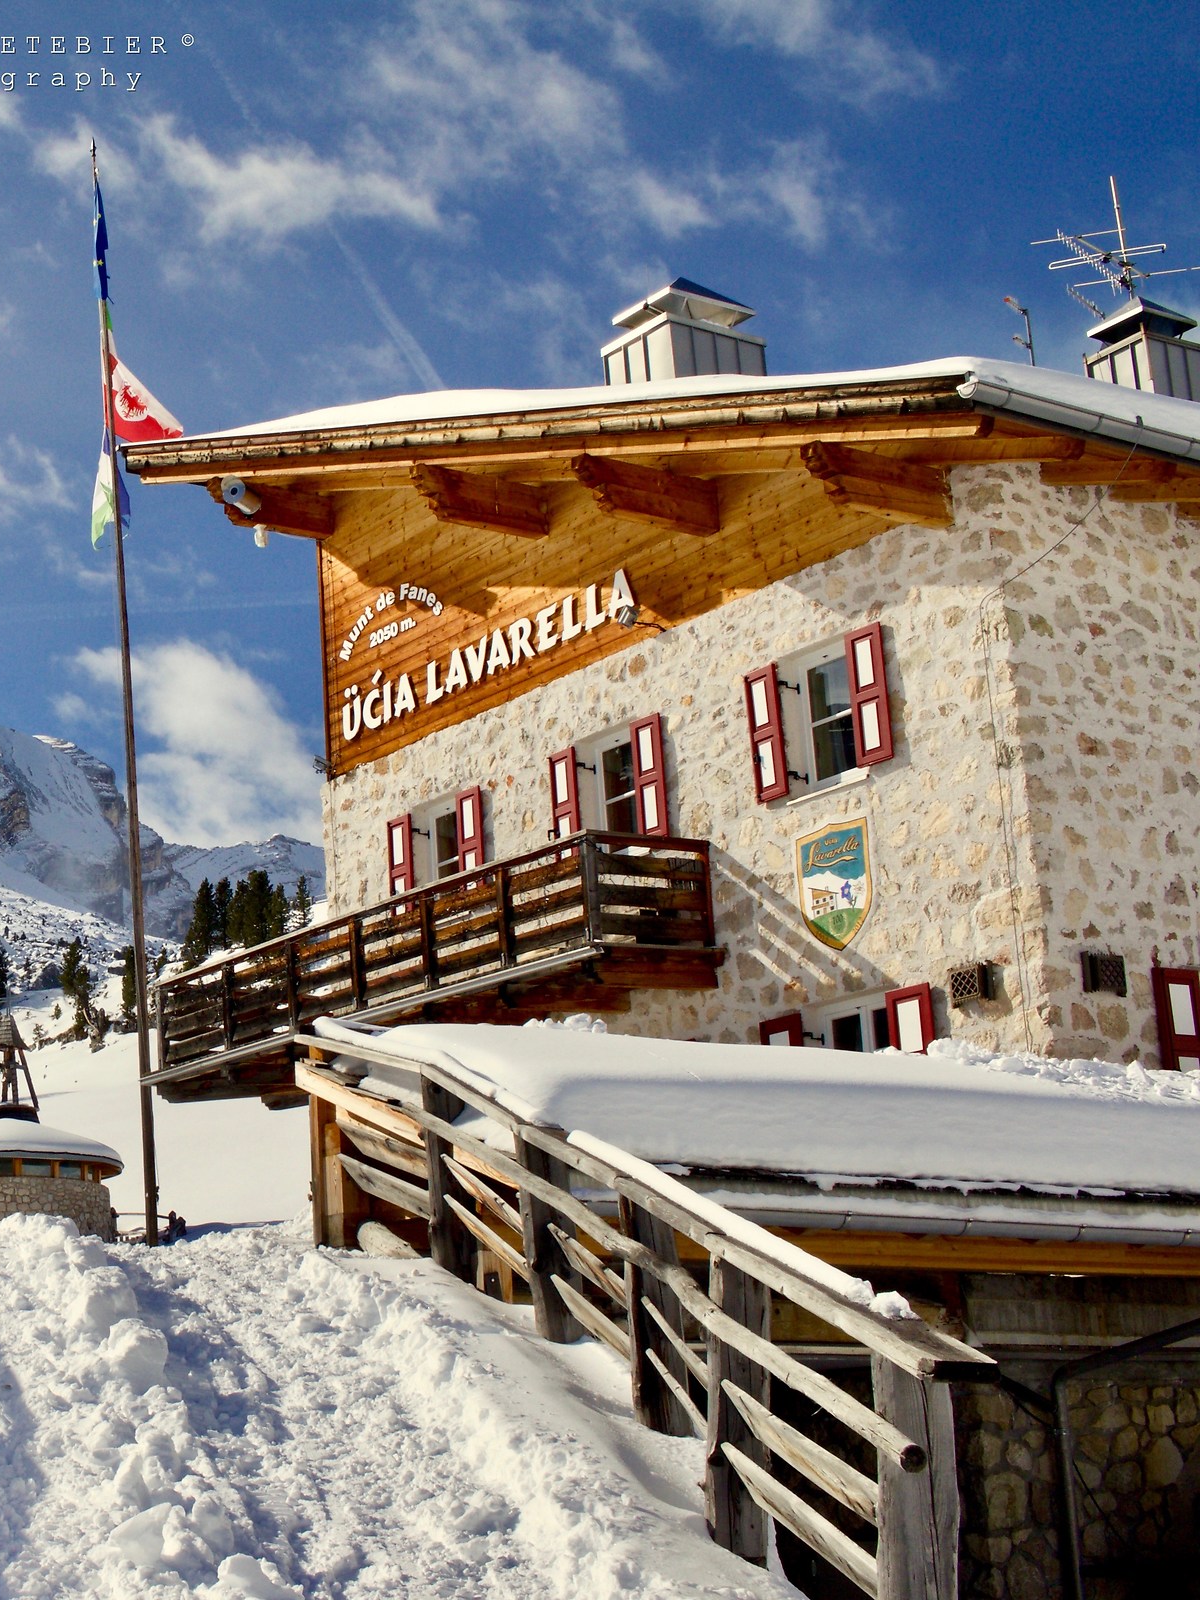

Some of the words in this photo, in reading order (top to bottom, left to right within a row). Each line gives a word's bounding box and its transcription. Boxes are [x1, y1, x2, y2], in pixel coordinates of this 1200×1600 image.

[339, 606, 375, 662] Munt
[376, 591, 396, 612] de
[400, 583, 444, 616] Fanes
[369, 622, 399, 648] 2050
[400, 617, 417, 633] m.
[425, 568, 635, 704] LAVARELLA
